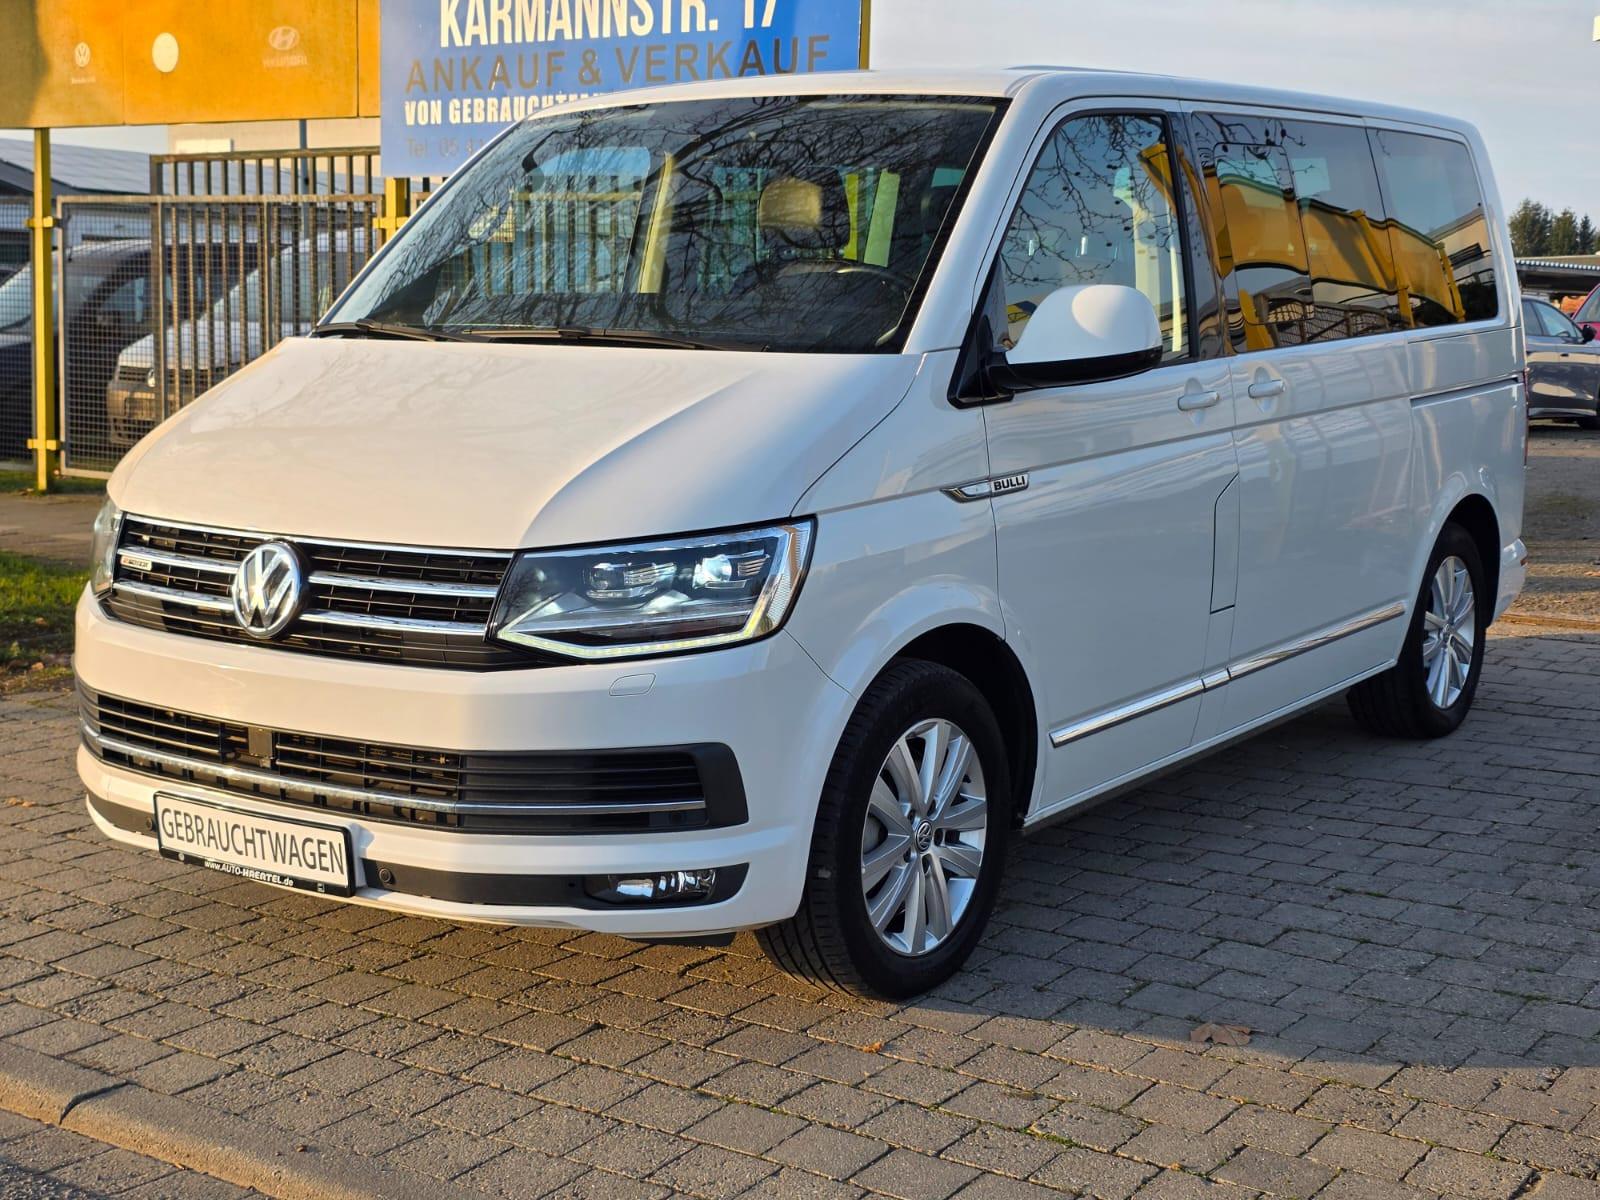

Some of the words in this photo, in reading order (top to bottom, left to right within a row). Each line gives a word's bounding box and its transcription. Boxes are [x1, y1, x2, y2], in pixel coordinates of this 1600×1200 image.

[405, 50, 566, 94] ANKAUF
[578, 48, 602, 86] &
[615, 34, 831, 84] VERKAUF
[404, 100, 442, 126] VON
[994, 476, 1025, 490] BULLI
[161, 807, 344, 875] GEBRAUCHTWAGEN
